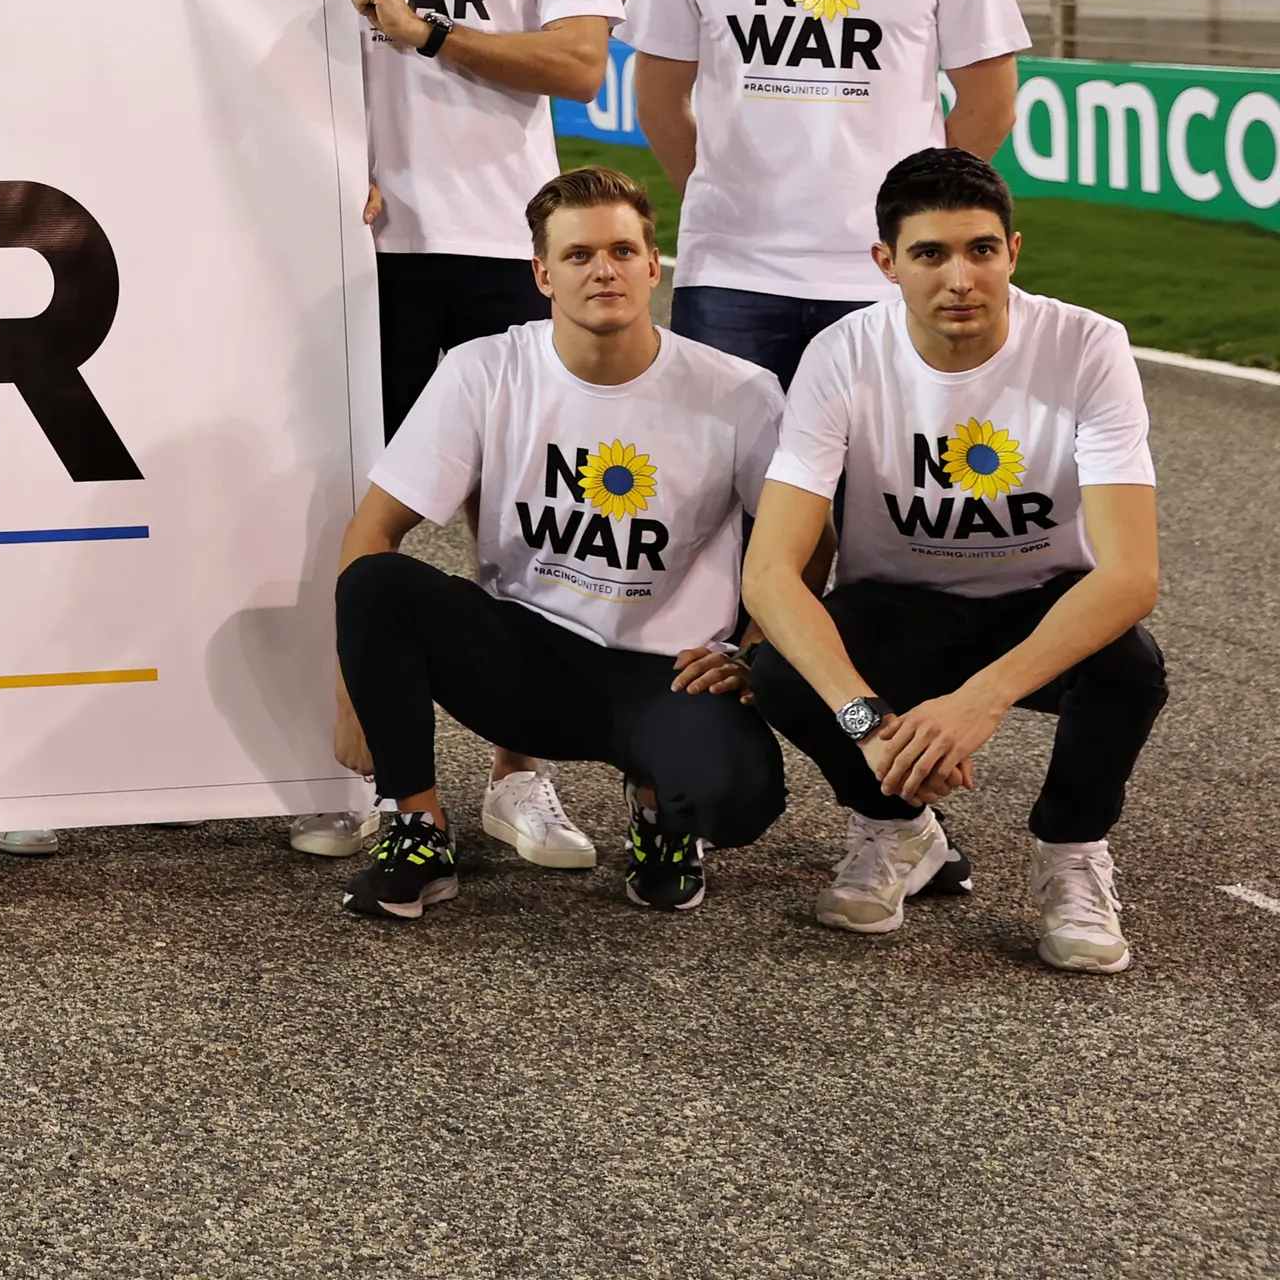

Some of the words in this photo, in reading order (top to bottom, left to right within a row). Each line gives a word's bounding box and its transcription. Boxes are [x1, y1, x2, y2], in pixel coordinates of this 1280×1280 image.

[726, 14, 883, 71] WAR
[744, 83, 830, 96] #RACINGUNITED
[842, 87, 869, 97] GPDA
[883, 492, 1059, 540] WAR
[516, 502, 669, 571] WAR
[1020, 542, 1051, 554] GPDA
[534, 565, 613, 595] #RACINGUNITED
[625, 588, 652, 598] GPDA
